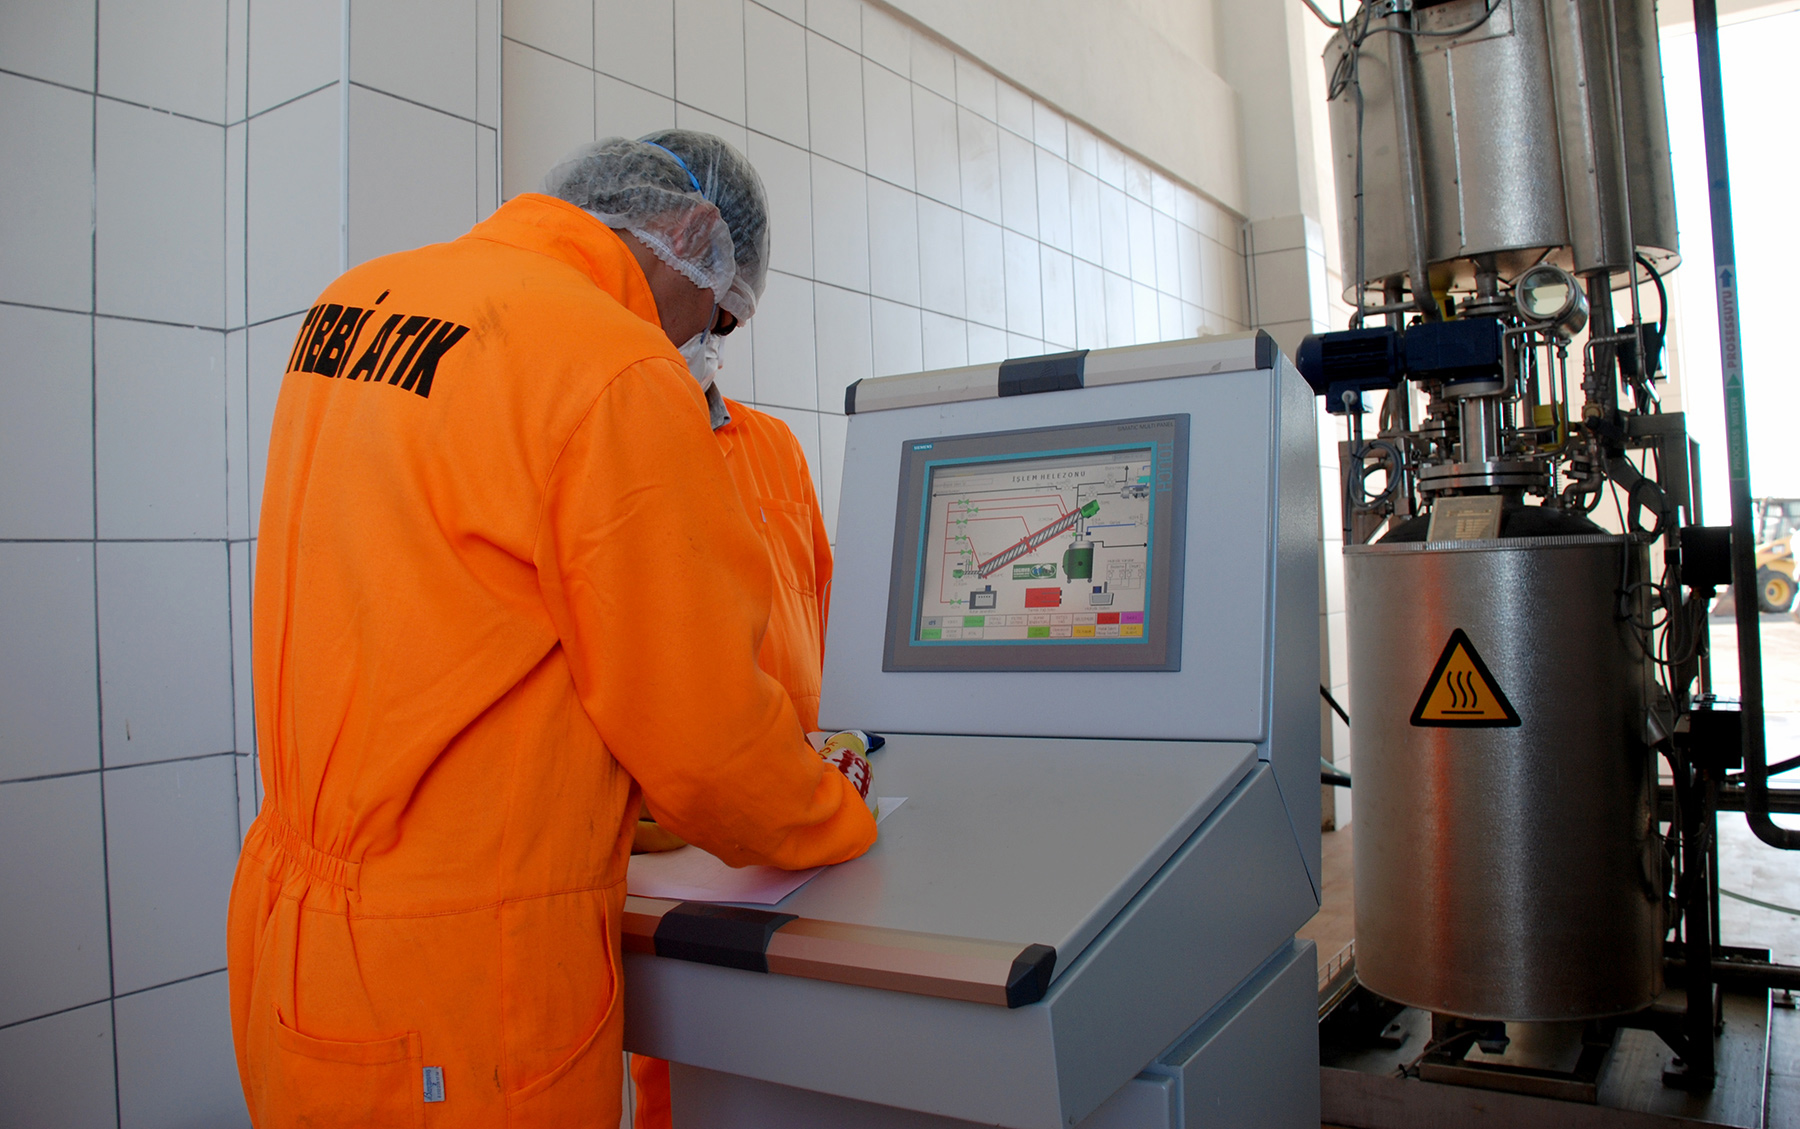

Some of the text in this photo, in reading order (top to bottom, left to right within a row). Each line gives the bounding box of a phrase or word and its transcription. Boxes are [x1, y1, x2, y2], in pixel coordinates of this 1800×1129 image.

[347, 313, 471, 399] ATIK
[1722, 290, 1737, 369] PROSESSUYU
[1117, 424, 1139, 432] SIMATIC
[1139, 422, 1156, 430] MULTI
[1730, 396, 1742, 470] PROCESS WATER
[1040, 471, 1086, 480] HELEZONU
[1157, 440, 1174, 492] TOUCH
